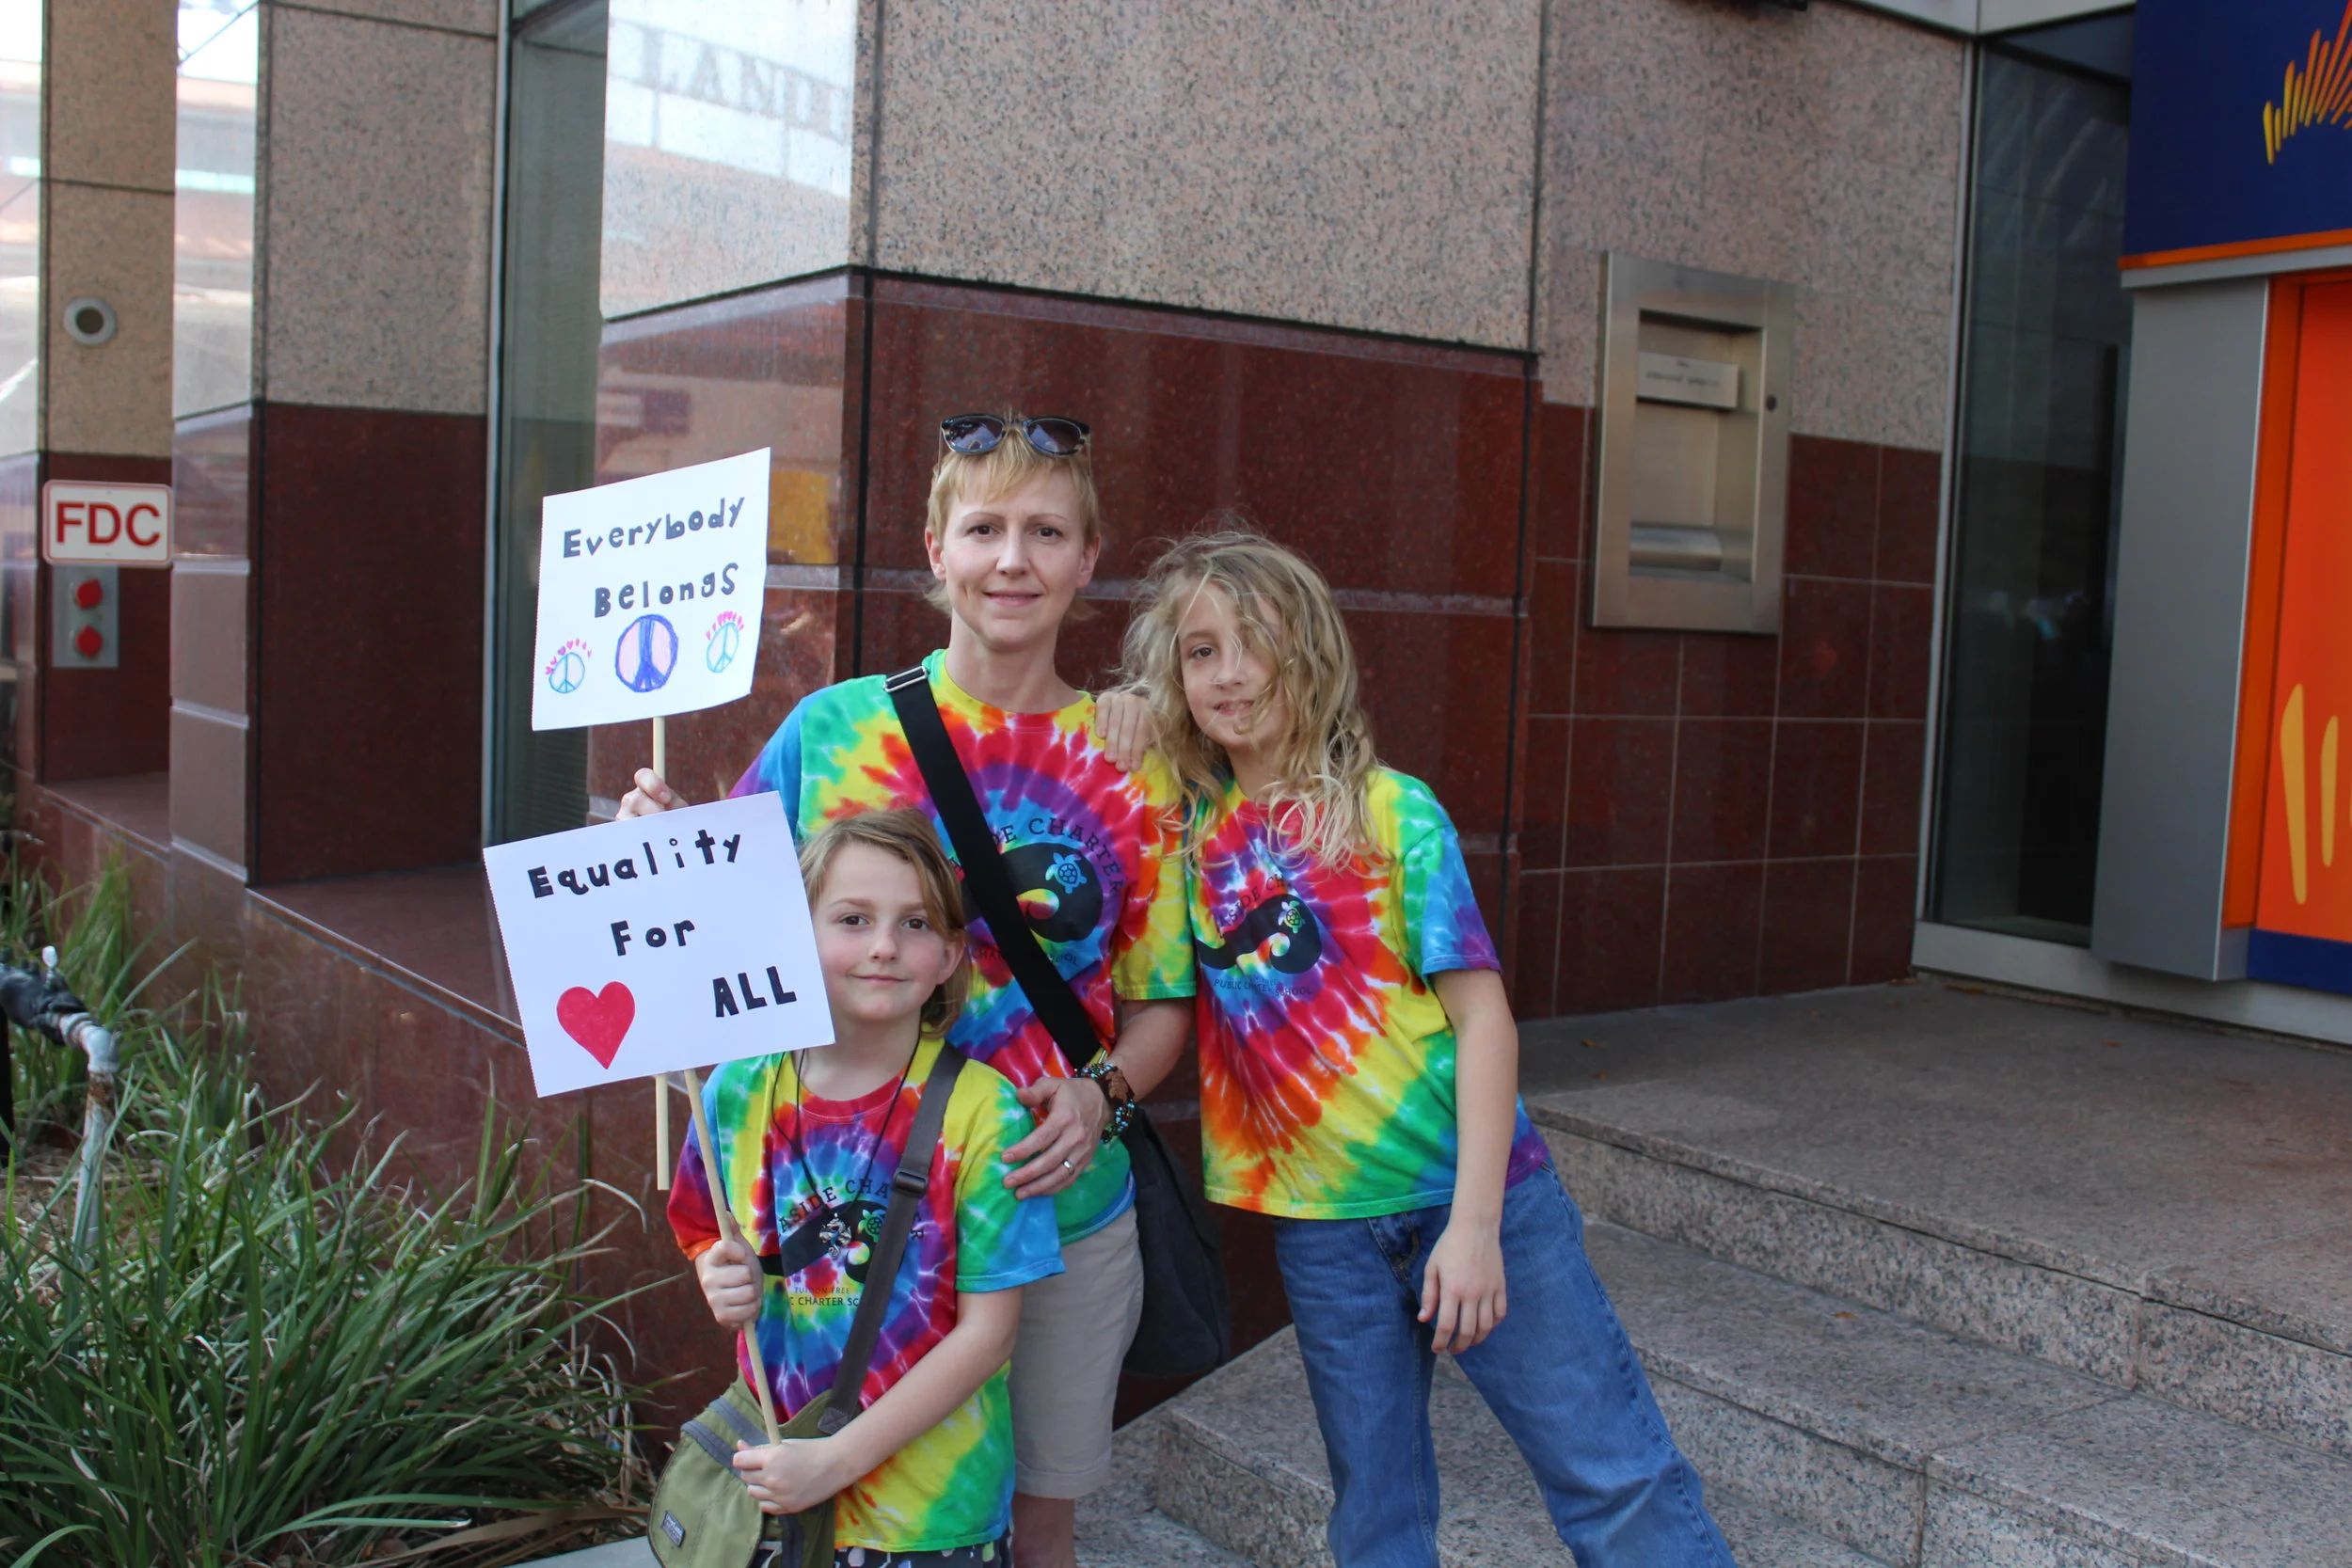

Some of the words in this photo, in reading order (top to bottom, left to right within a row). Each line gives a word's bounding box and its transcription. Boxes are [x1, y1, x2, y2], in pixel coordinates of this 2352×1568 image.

[56, 500, 161, 547] FDC
[563, 497, 745, 559] Everybody
[527, 829, 740, 898] Equality
[611, 920, 695, 957] For
[712, 966, 797, 1018] ALL
[798, 1296, 843, 1306] CHARTER
